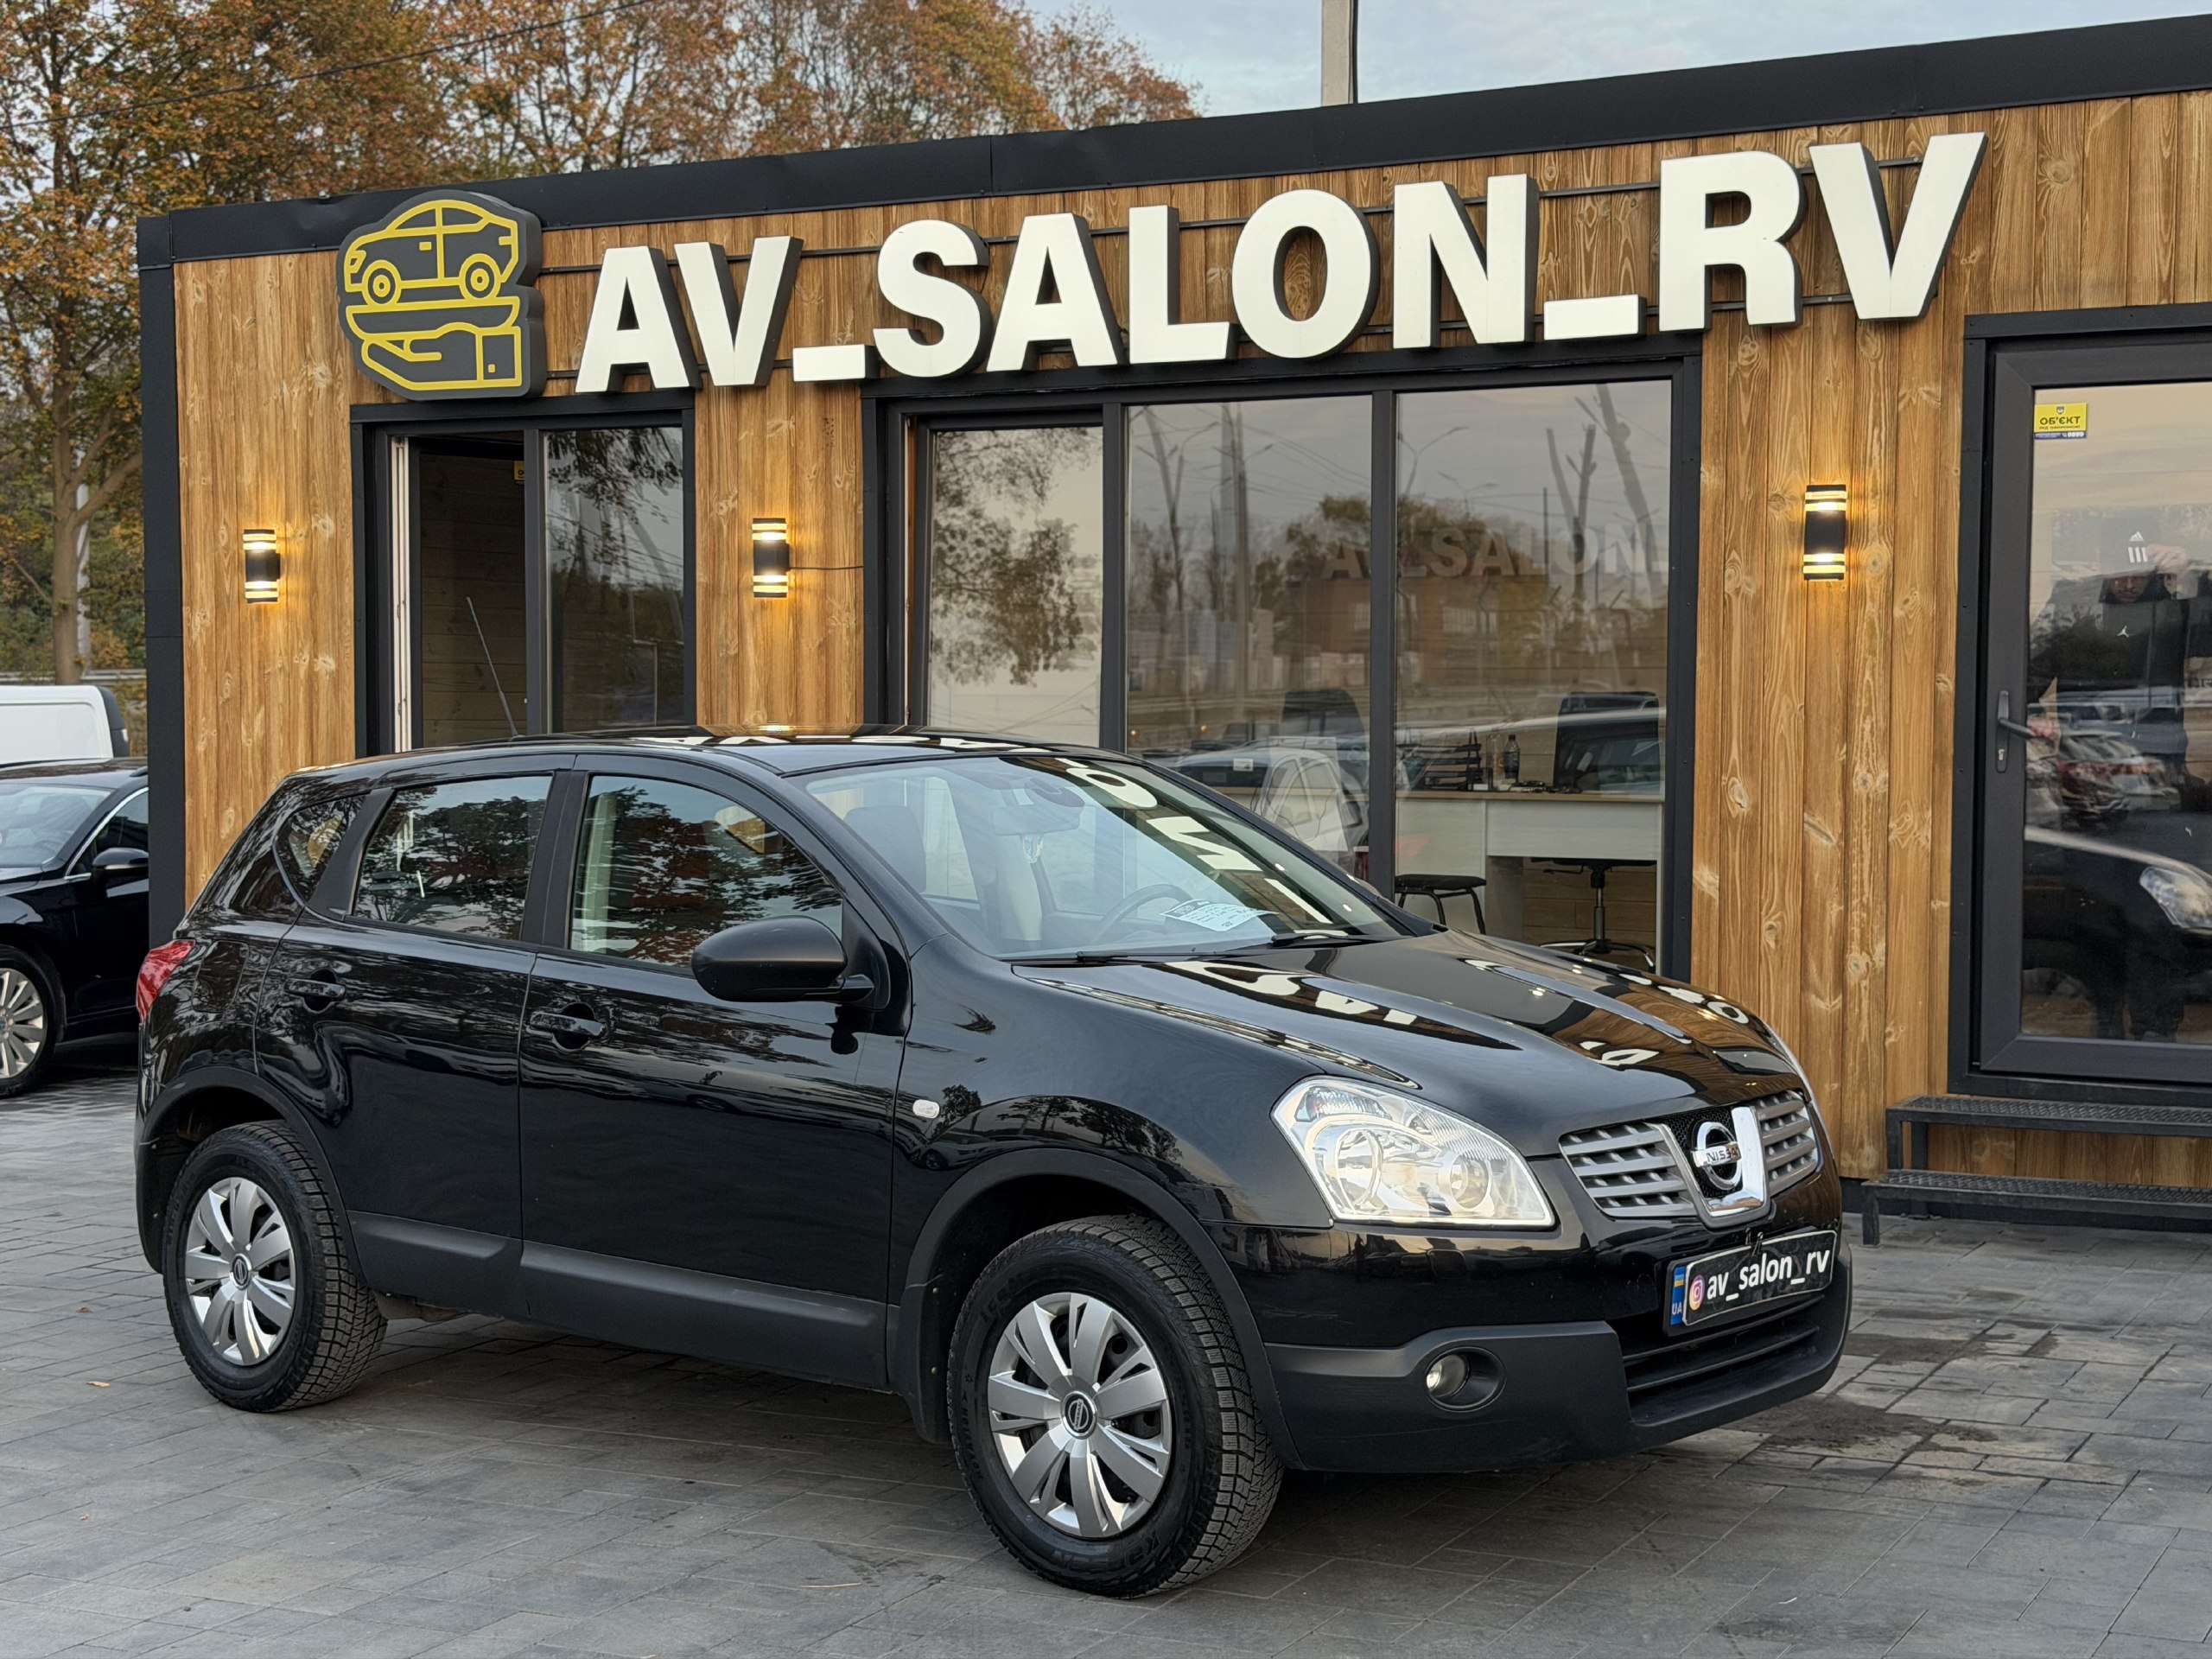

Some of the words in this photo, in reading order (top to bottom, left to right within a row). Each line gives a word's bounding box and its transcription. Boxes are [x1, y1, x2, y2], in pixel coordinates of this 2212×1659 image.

[575, 131, 1986, 393] AV_SALON_RV
[1707, 1249, 1831, 1301] av_salon_rv
[1671, 1301, 1683, 1316] UA
